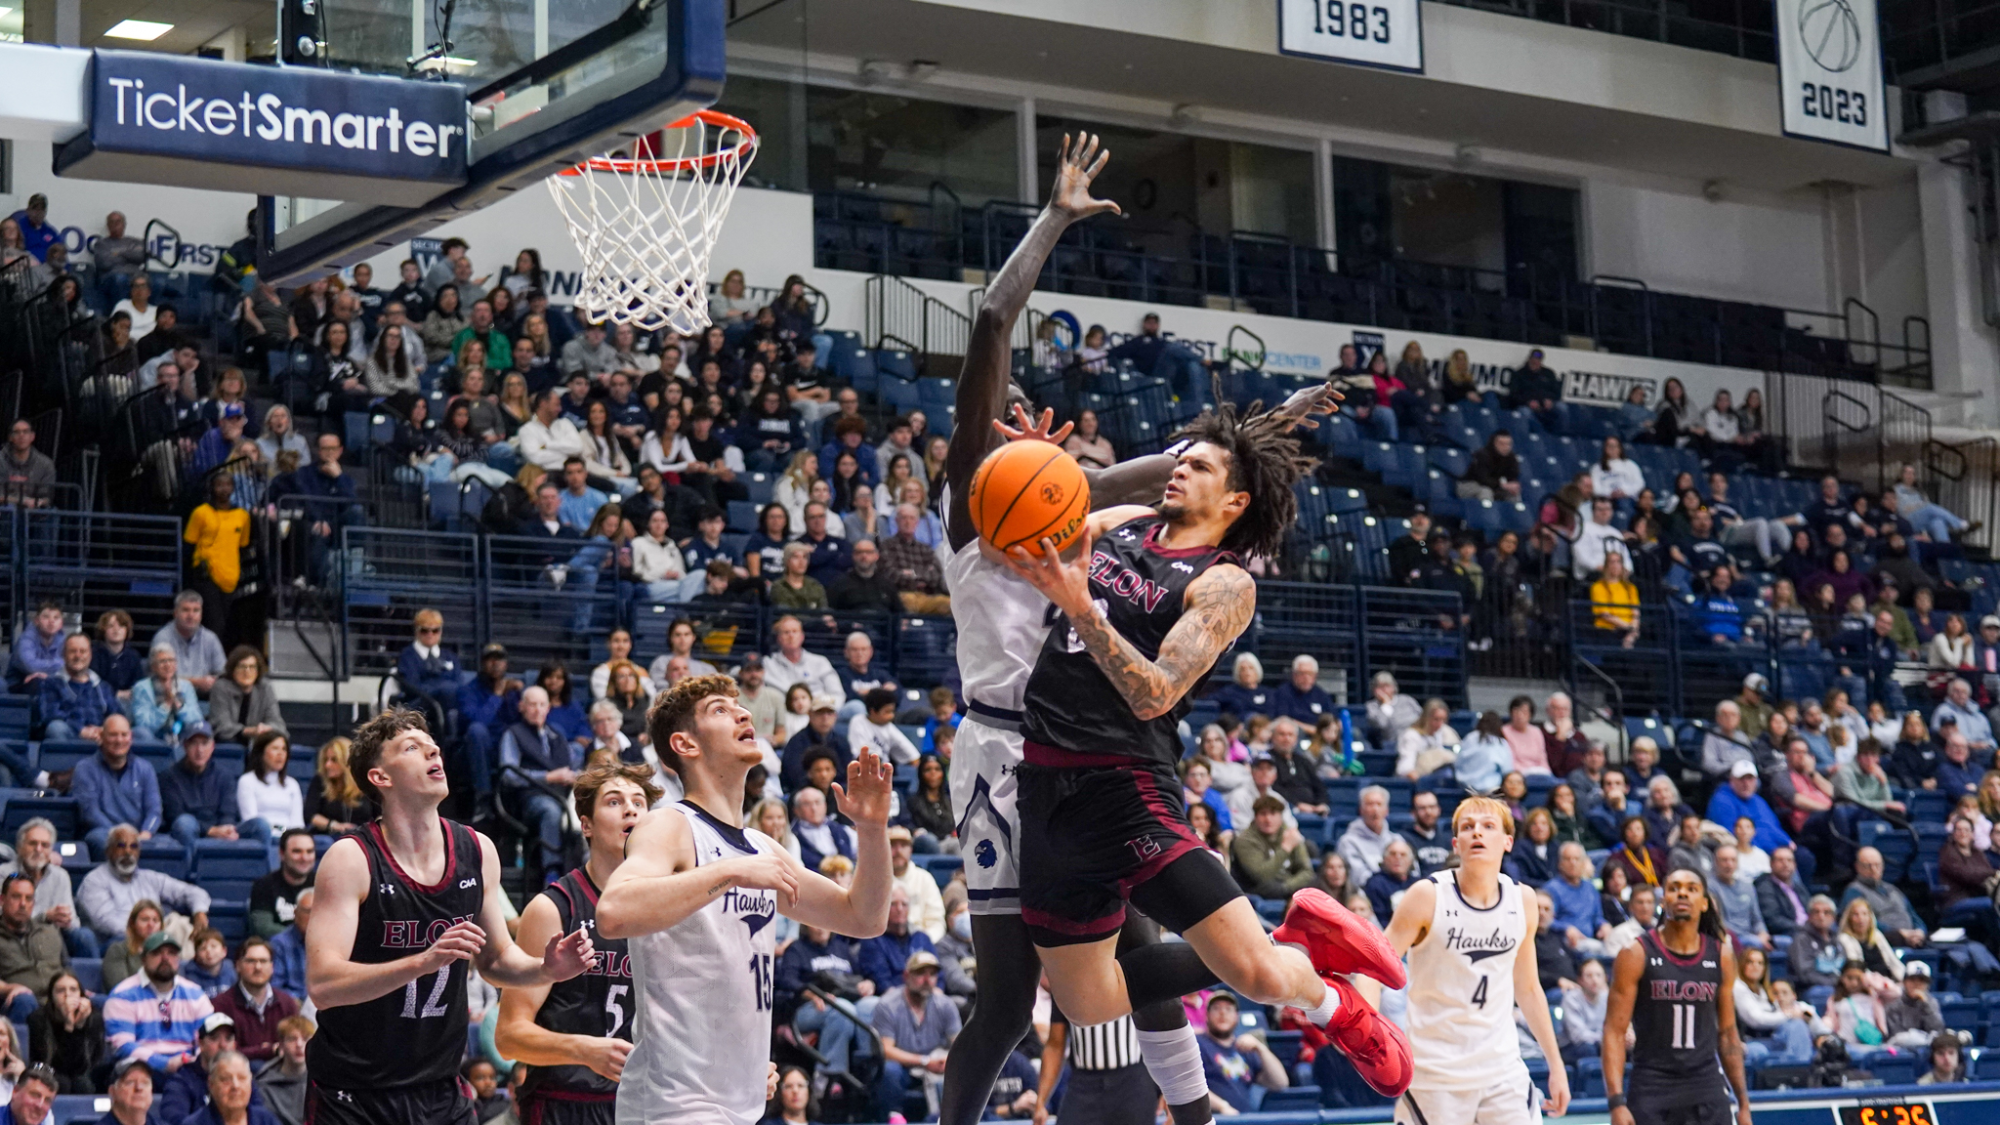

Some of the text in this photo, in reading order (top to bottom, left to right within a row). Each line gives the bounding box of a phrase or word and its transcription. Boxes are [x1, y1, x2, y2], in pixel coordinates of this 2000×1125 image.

[1314, 0, 1390, 43] 1983
[1802, 82, 1867, 127] 2023
[1265, 350, 1322, 370] CENTER
[1361, 345, 1377, 369] Y
[1087, 550, 1169, 614] ELON
[459, 878, 477, 889] CAA
[1446, 927, 1516, 950] Hawks
[749, 952, 773, 1012] 15
[1470, 974, 1489, 1010] 4
[1650, 980, 1719, 1002] ELON
[605, 984, 629, 1038] 5
[1671, 1004, 1696, 1050] 11
